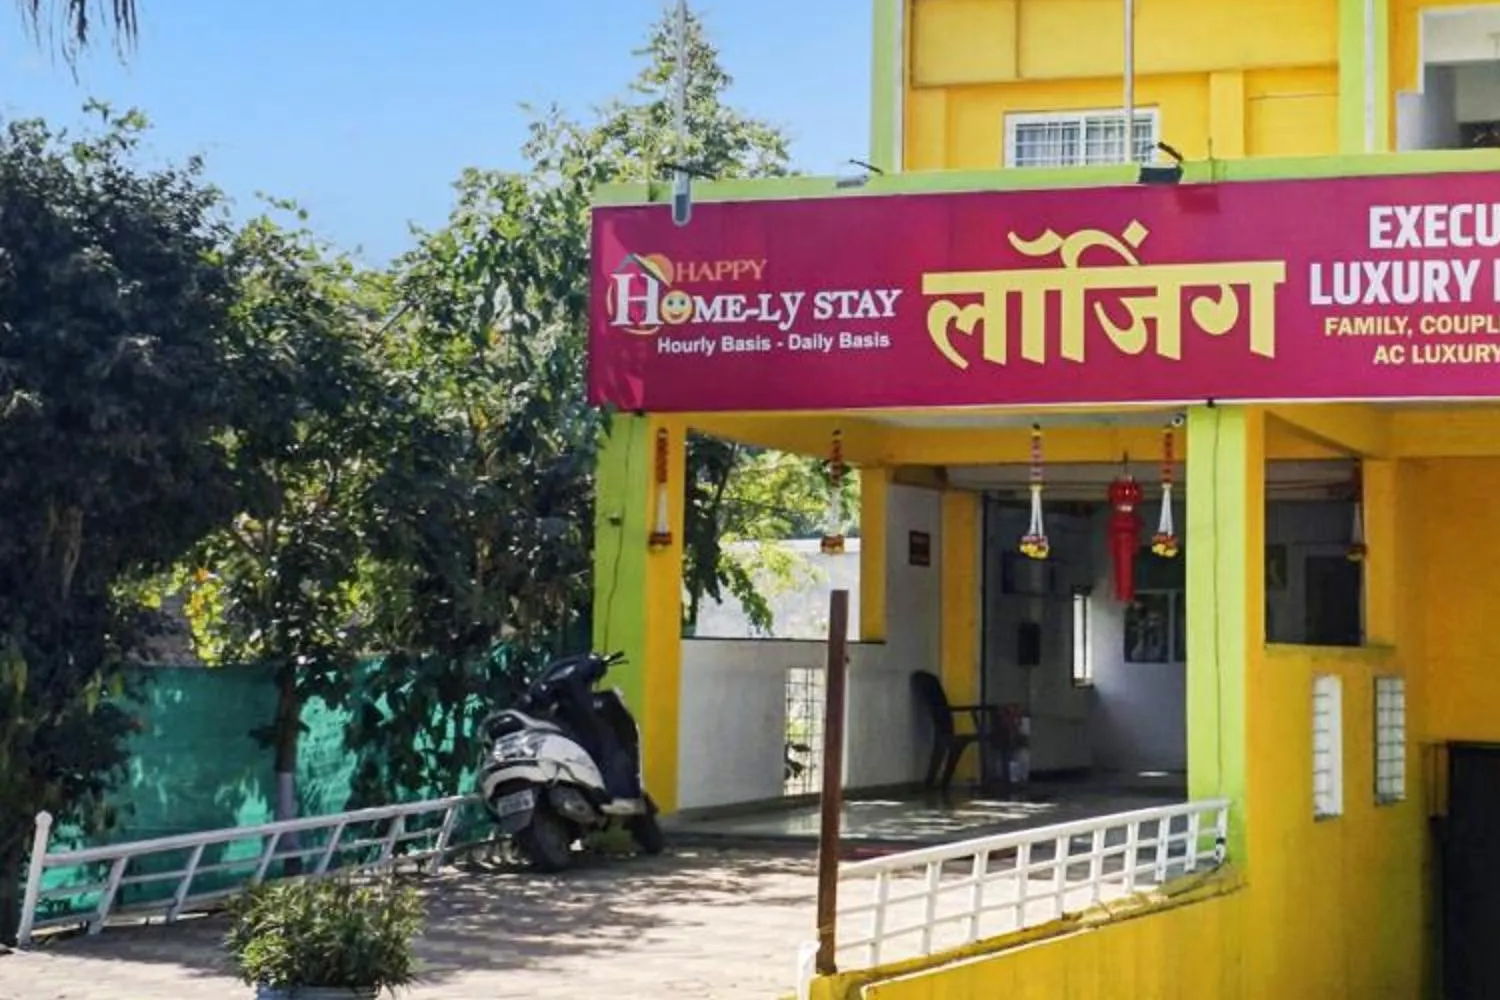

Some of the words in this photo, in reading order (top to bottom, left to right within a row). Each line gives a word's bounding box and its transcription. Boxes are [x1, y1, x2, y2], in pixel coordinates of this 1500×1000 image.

[676, 258, 769, 283] HAPPY
[1309, 257, 1481, 306] LUXURY
[813, 289, 903, 320] STAY
[921, 218, 1286, 370] लॉजिंग
[1324, 314, 1414, 338] FAMILY,
[657, 336, 717, 357] Hourly
[721, 335, 772, 353] Basis
[788, 331, 834, 353] Daily
[839, 331, 891, 350] Basis
[1373, 343, 1406, 366] AC
